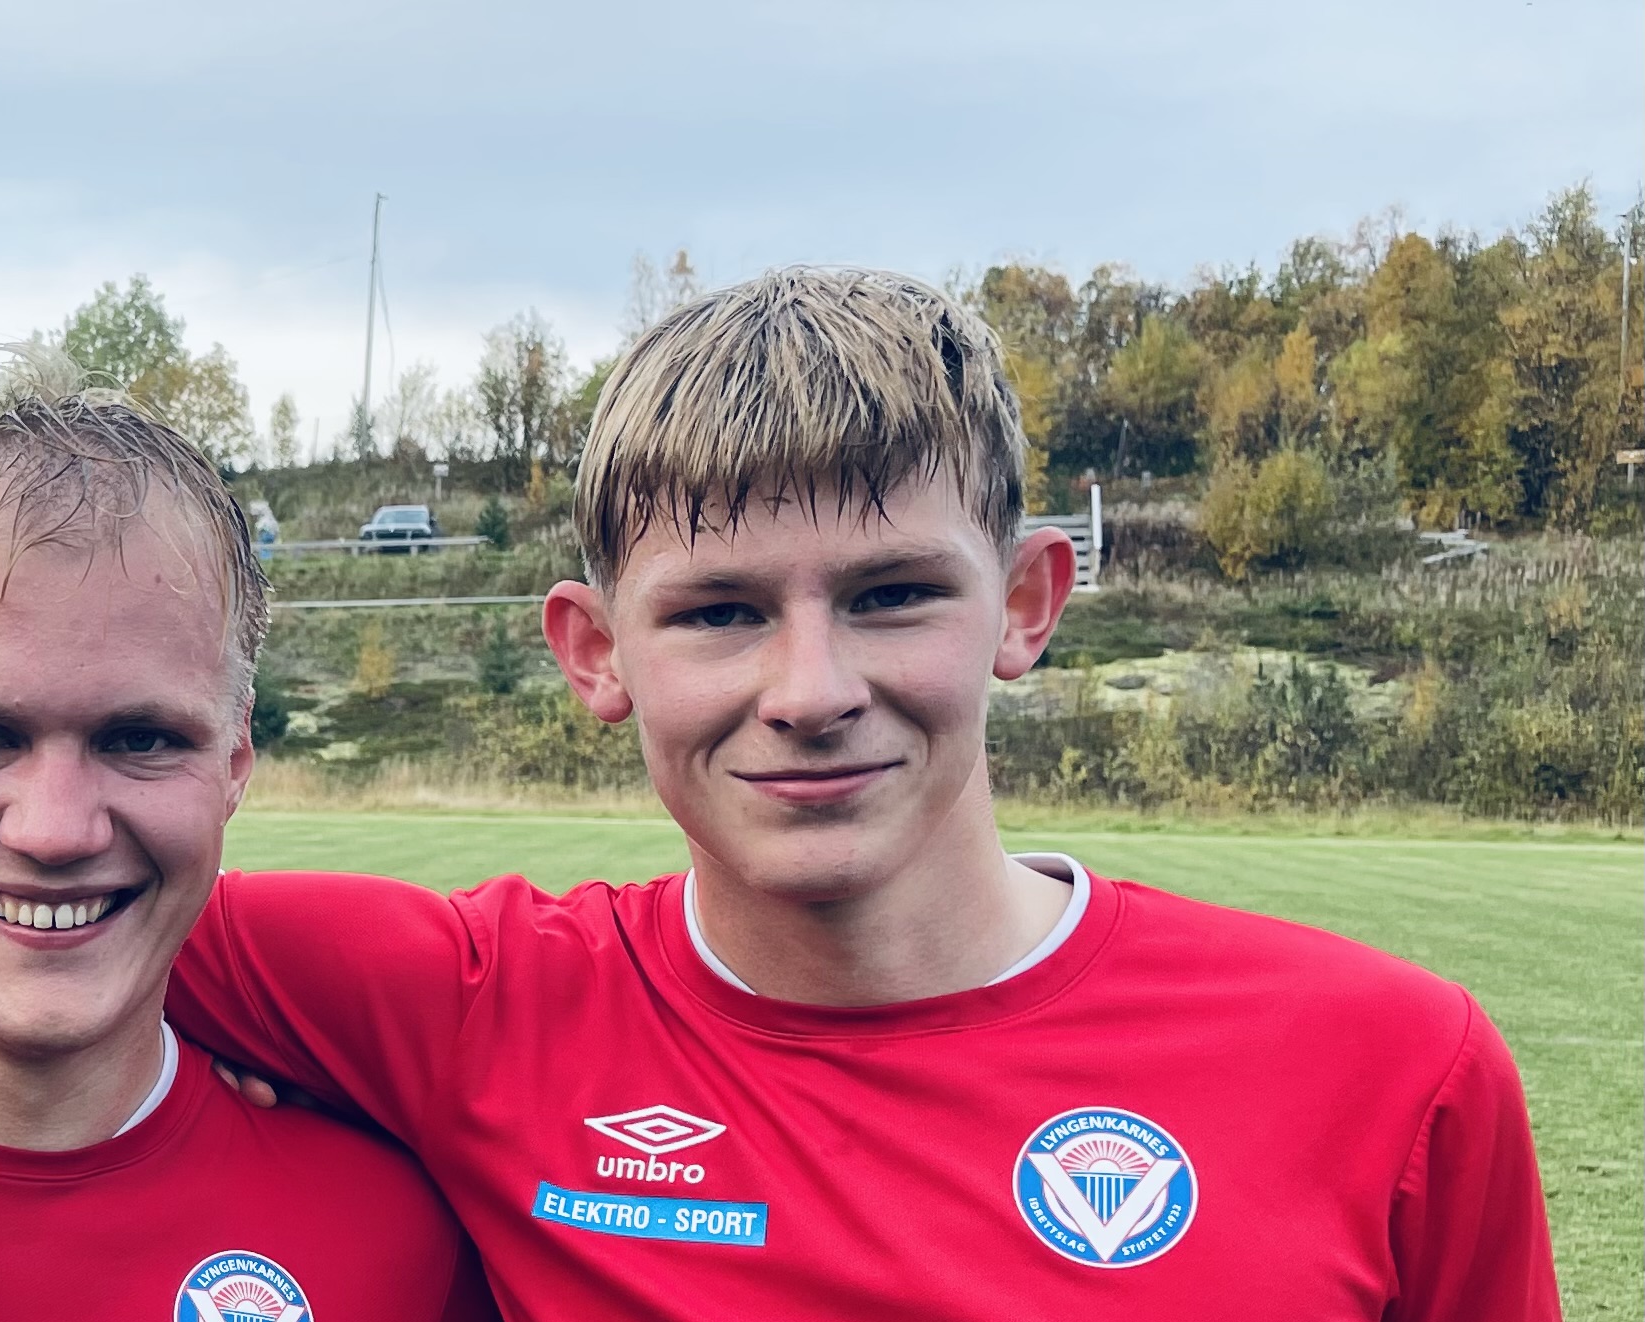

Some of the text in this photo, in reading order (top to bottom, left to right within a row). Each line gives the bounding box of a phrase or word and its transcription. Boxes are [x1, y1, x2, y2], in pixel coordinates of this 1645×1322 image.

[1040, 1116, 1170, 1157] LYNGEN/KARNES
[597, 1154, 705, 1184] umbro
[543, 1192, 650, 1230] ELEKTRO
[674, 1208, 758, 1237] SPORT
[1028, 1197, 1087, 1253] IDRETTSLAG
[197, 1259, 297, 1302] LYNGEN/KARNES
